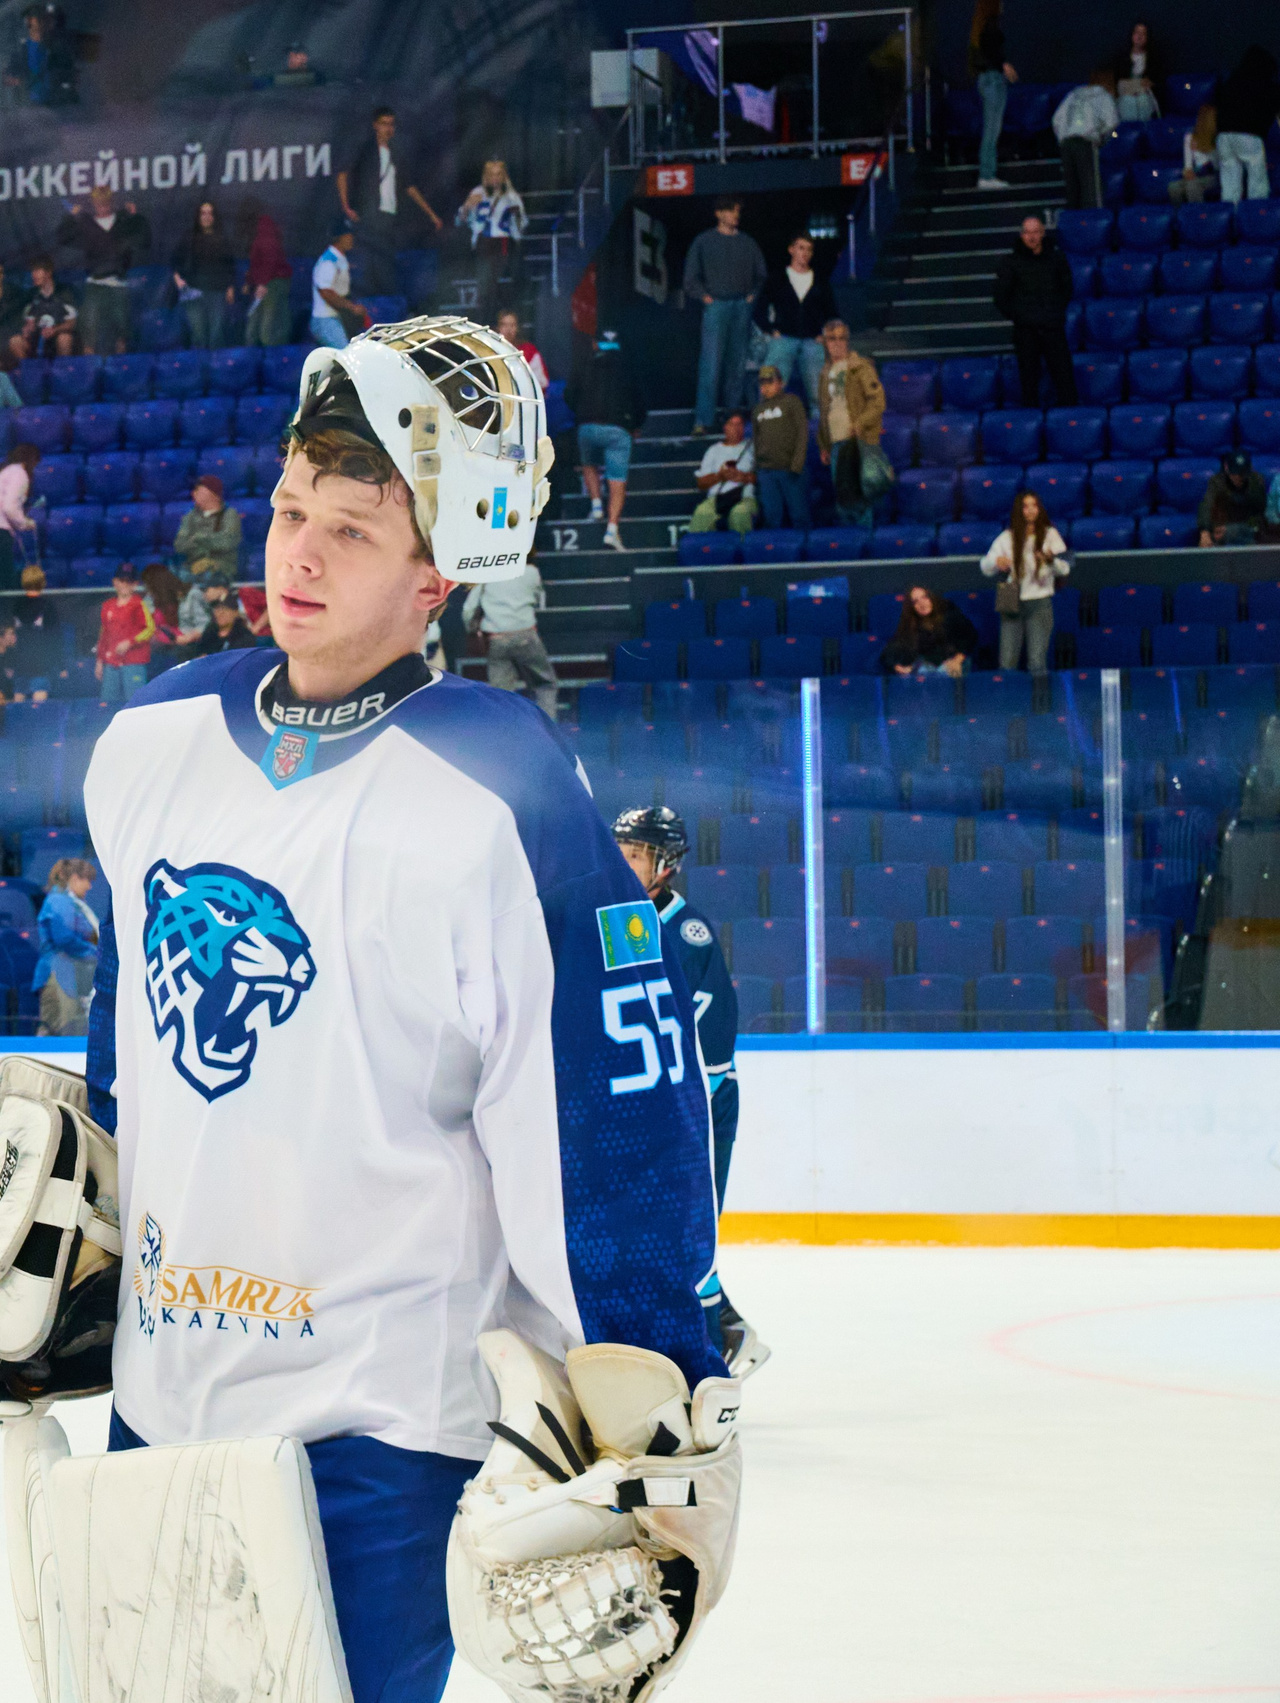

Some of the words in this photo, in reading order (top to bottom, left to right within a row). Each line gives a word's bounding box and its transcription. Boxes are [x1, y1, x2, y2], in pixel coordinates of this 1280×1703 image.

[220, 142, 332, 184] ЛИГИ
[656, 169, 688, 192] E3
[551, 528, 580, 551] 12
[666, 524, 690, 548] 1
[456, 552, 521, 570] BAUER
[271, 691, 387, 727] BAUER
[600, 976, 685, 1096] 55
[160, 1268, 315, 1317] SAMRUK
[161, 1307, 315, 1340] KAZYNA
